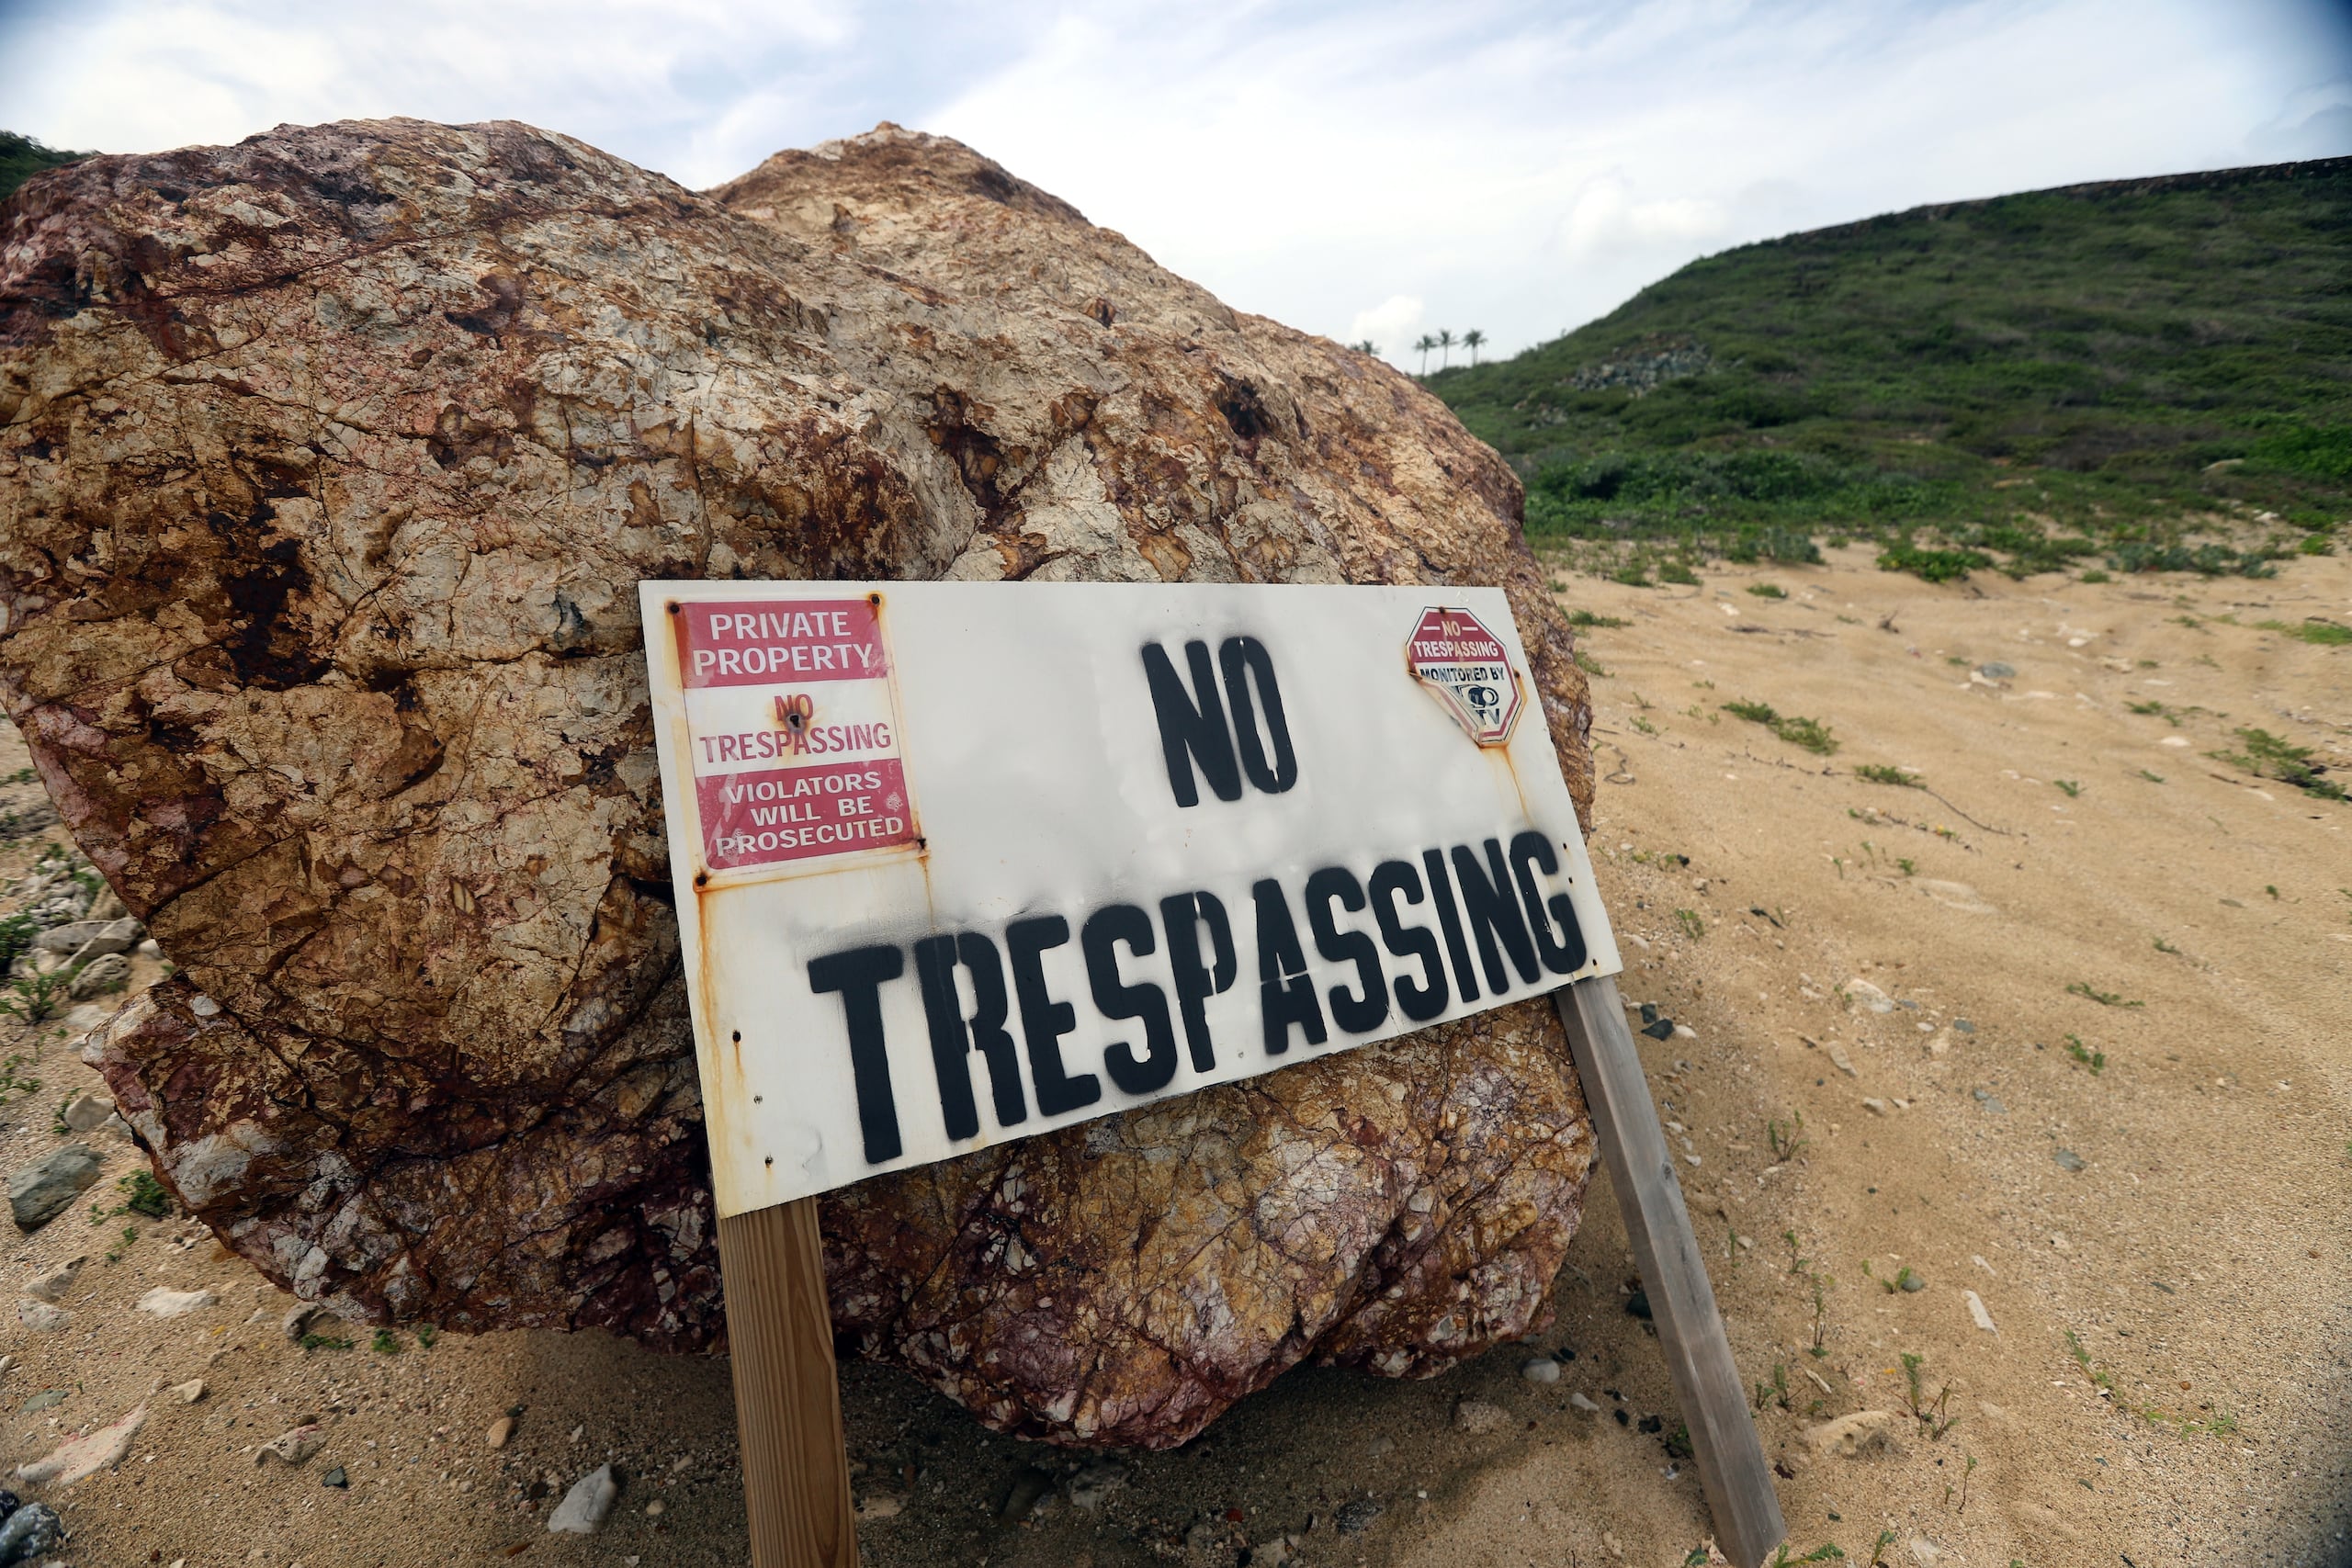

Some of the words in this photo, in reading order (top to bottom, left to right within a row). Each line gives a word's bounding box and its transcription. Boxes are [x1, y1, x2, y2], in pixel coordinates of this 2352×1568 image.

[709, 611, 852, 640] PRIVATE
[1442, 620, 1462, 637] NO
[693, 643, 873, 676] PROPERTY
[1414, 641, 1499, 657] TRESPASSING
[1419, 667, 1488, 682] MONITORED
[1491, 667, 1505, 681] BY
[775, 694, 814, 721] NO
[1142, 636, 1297, 807] NO
[699, 722, 891, 763] TRESPASSING
[725, 771, 881, 804] VIOLATORS
[750, 803, 821, 827] WILL
[838, 796, 873, 817] BE
[716, 817, 903, 857] PROSECUTED
[808, 830, 1587, 1165] TRESPASSING
